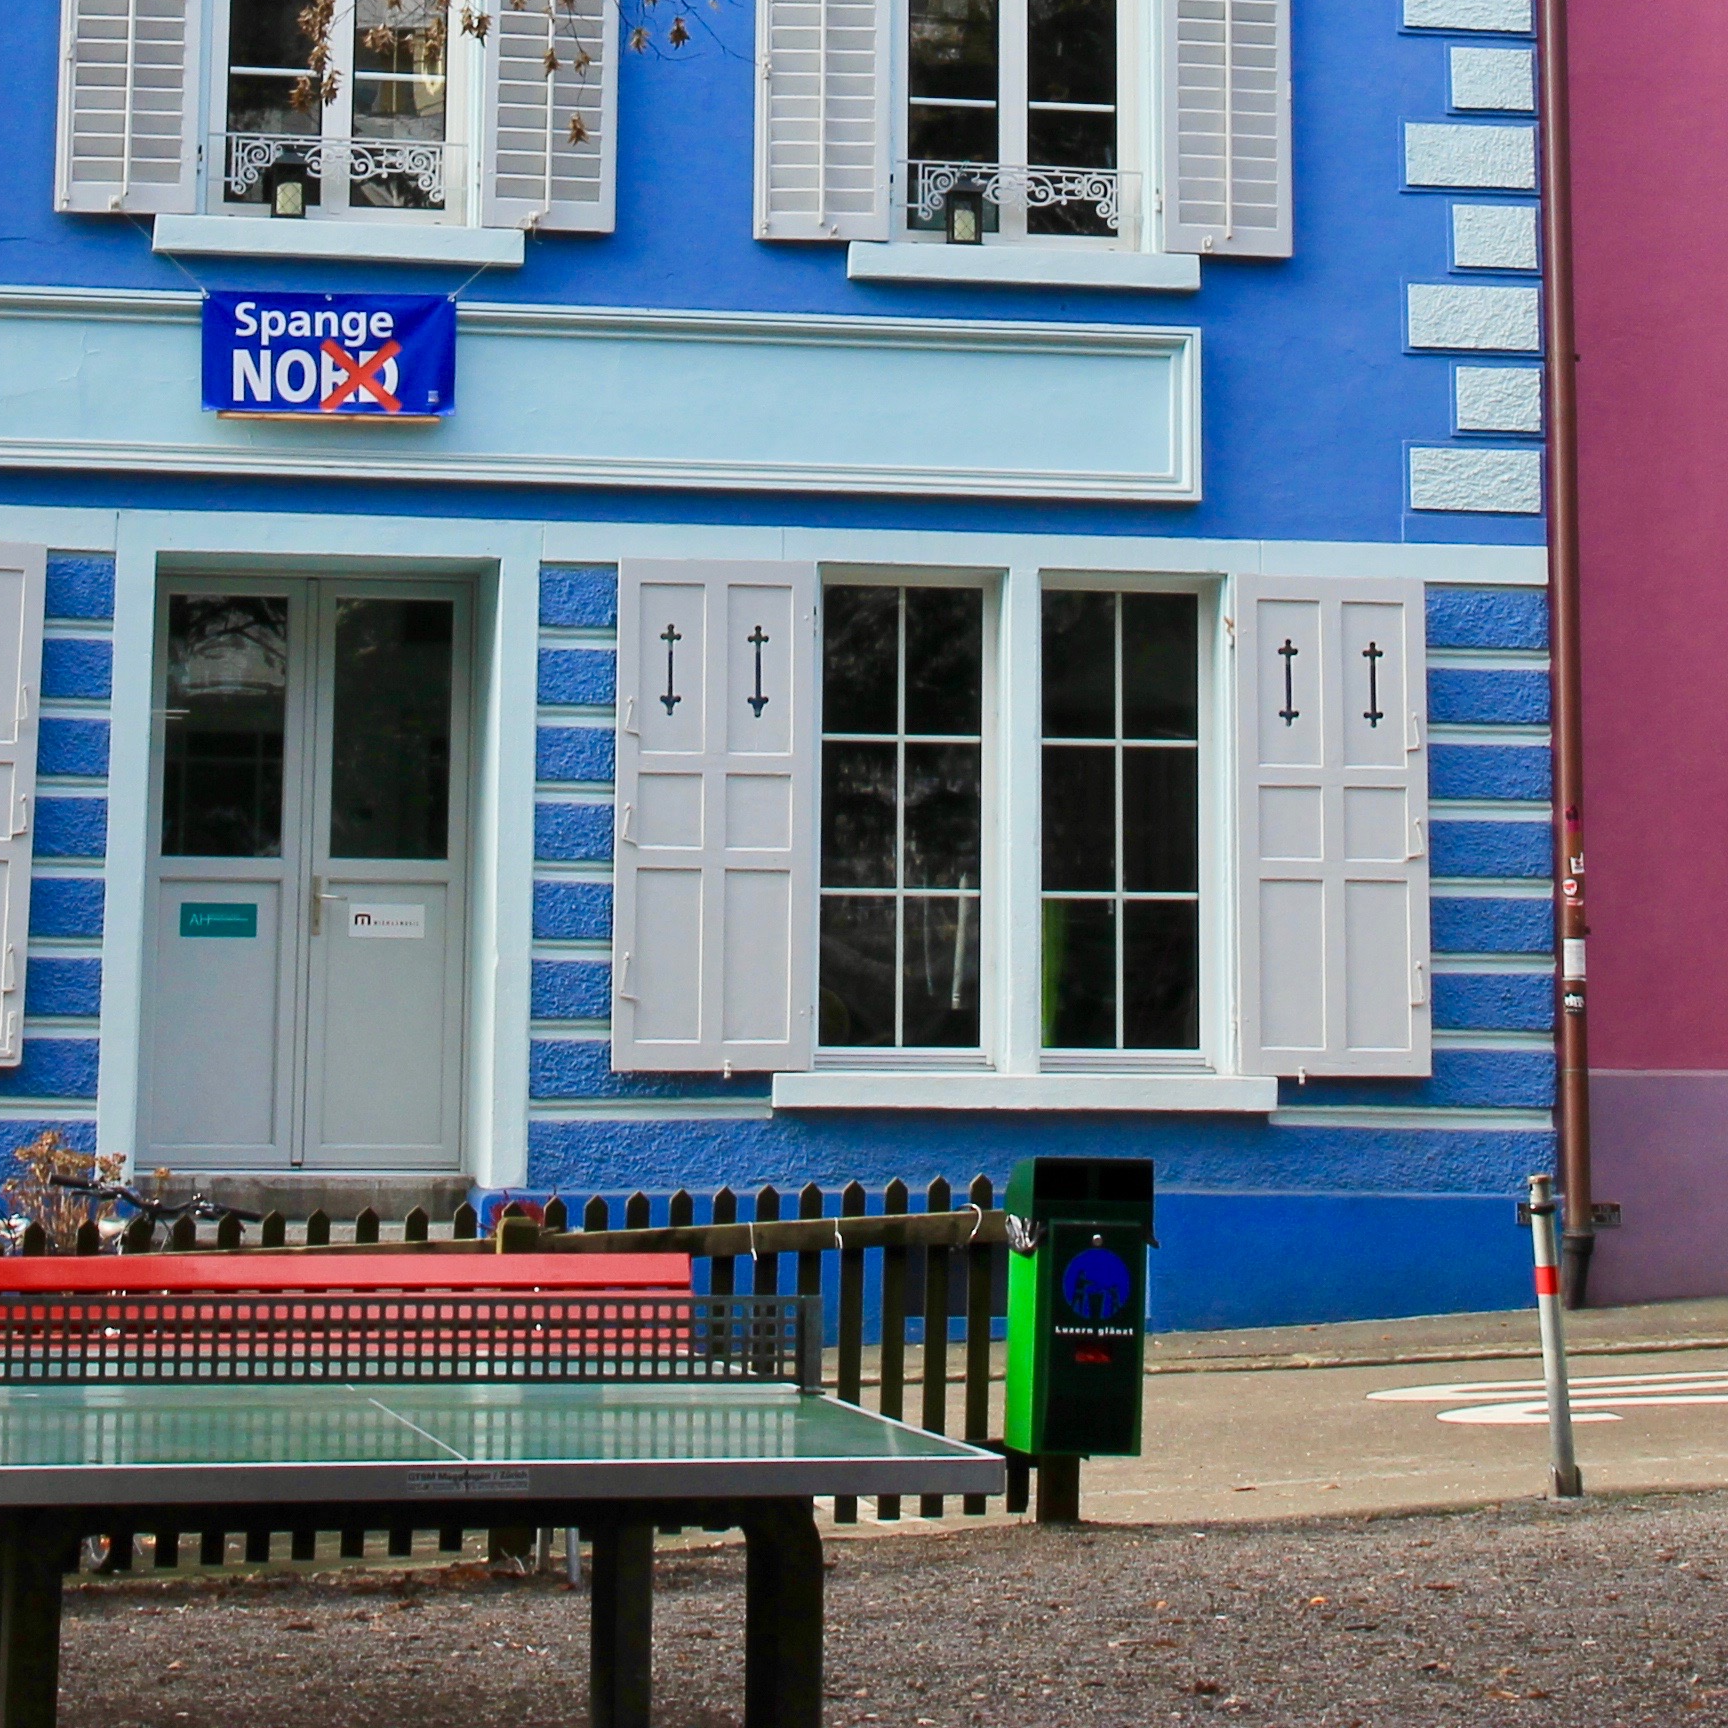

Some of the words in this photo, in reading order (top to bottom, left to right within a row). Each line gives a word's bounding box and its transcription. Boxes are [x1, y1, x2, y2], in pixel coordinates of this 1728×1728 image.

[234, 301, 394, 346] Spange
[1055, 1325, 1093, 1334] Luzern
[1098, 1327, 1133, 1336] glänzt
